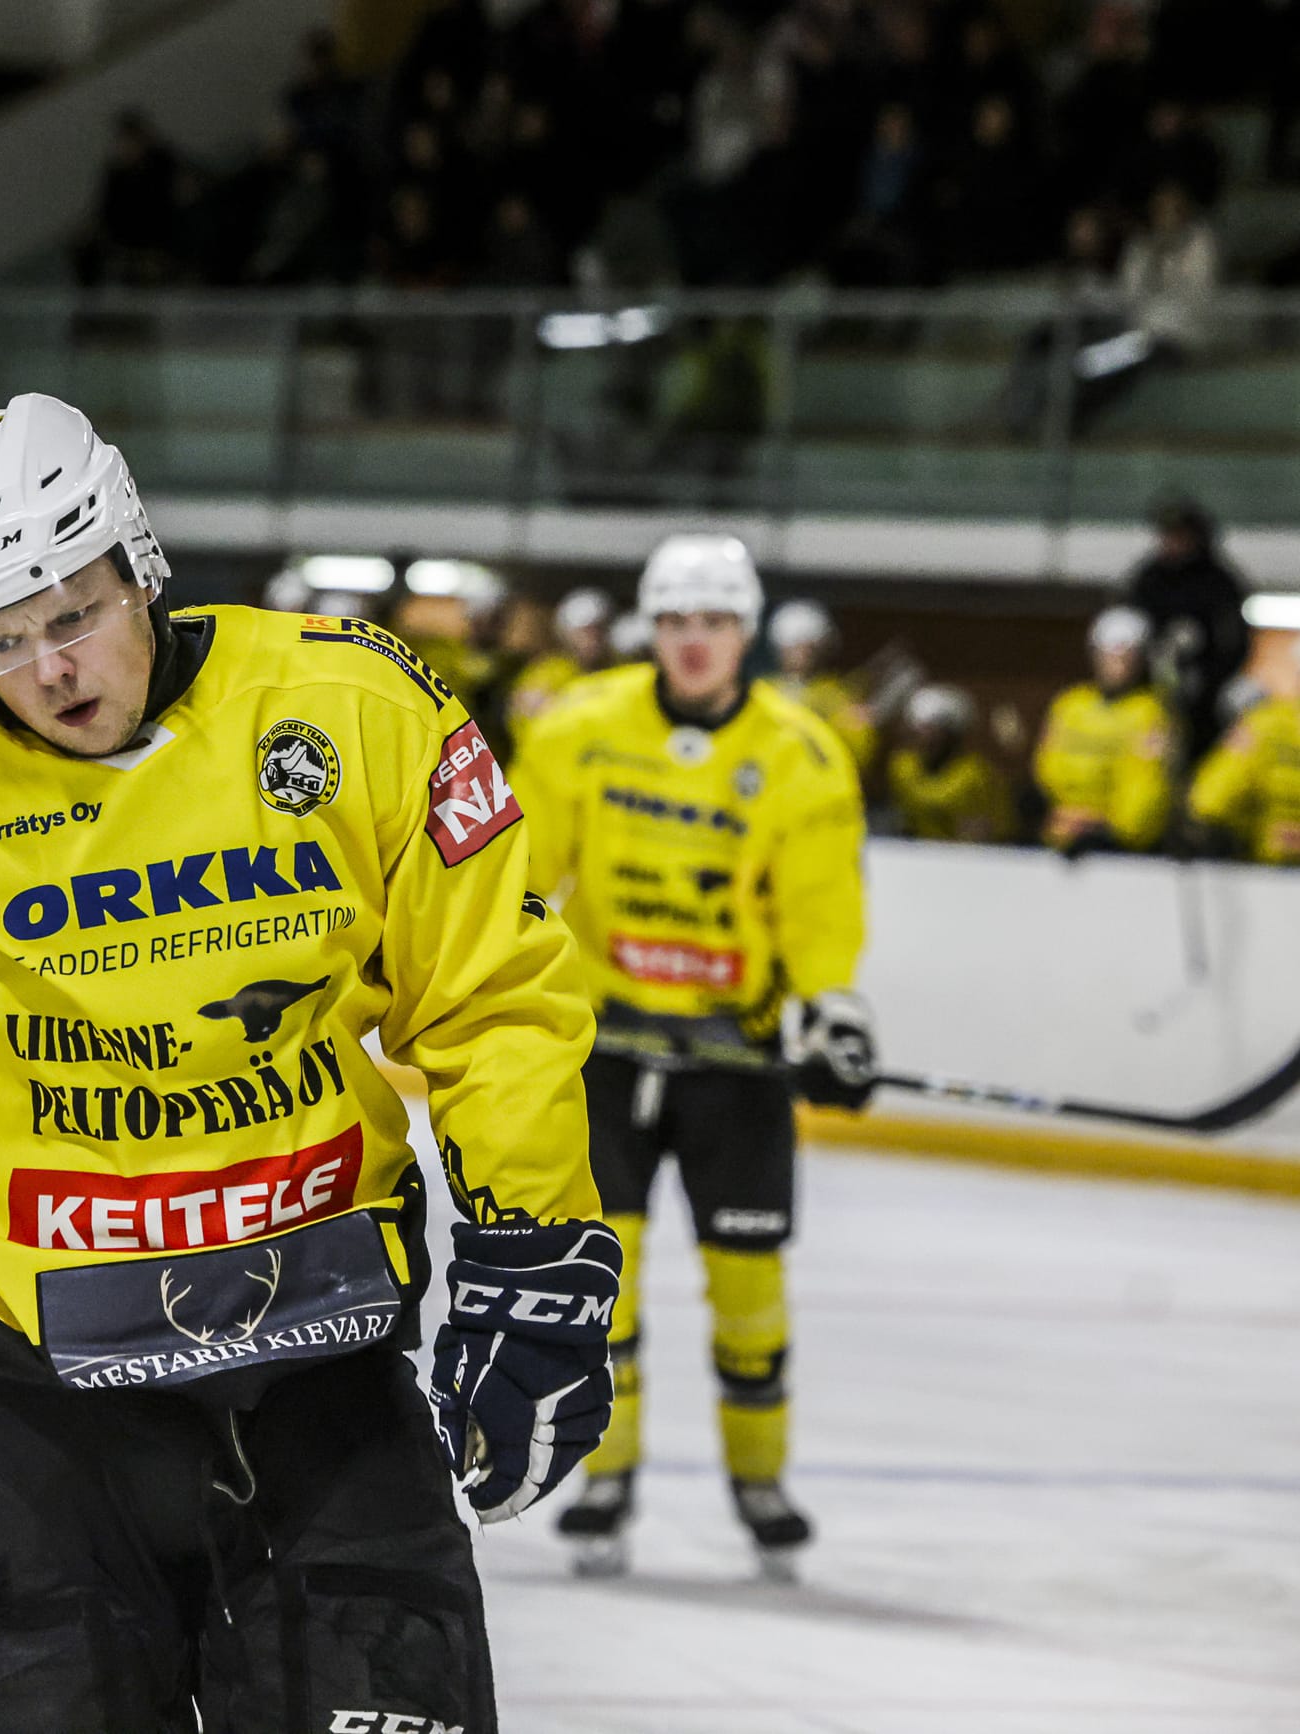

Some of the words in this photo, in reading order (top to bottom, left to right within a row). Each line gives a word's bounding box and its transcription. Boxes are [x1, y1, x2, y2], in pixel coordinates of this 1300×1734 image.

[340, 618, 454, 700] Rauta
[270, 722, 306, 737] HOCKEY
[306, 727, 329, 749] TEAM
[433, 736, 488, 789] EBA
[71, 802, 103, 822] Oy
[433, 761, 515, 846] NA
[151, 906, 357, 963] REFRIGERATION
[5, 1014, 193, 1071] LIIKENNE-
[28, 1050, 294, 1141] PELTOPERÄ
[298, 1036, 346, 1107] OY
[37, 1158, 343, 1250] KEITELE
[454, 1280, 614, 1326] CCM
[71, 1339, 259, 1390] MESTARIN
[265, 1314, 396, 1350] KIEVARI
